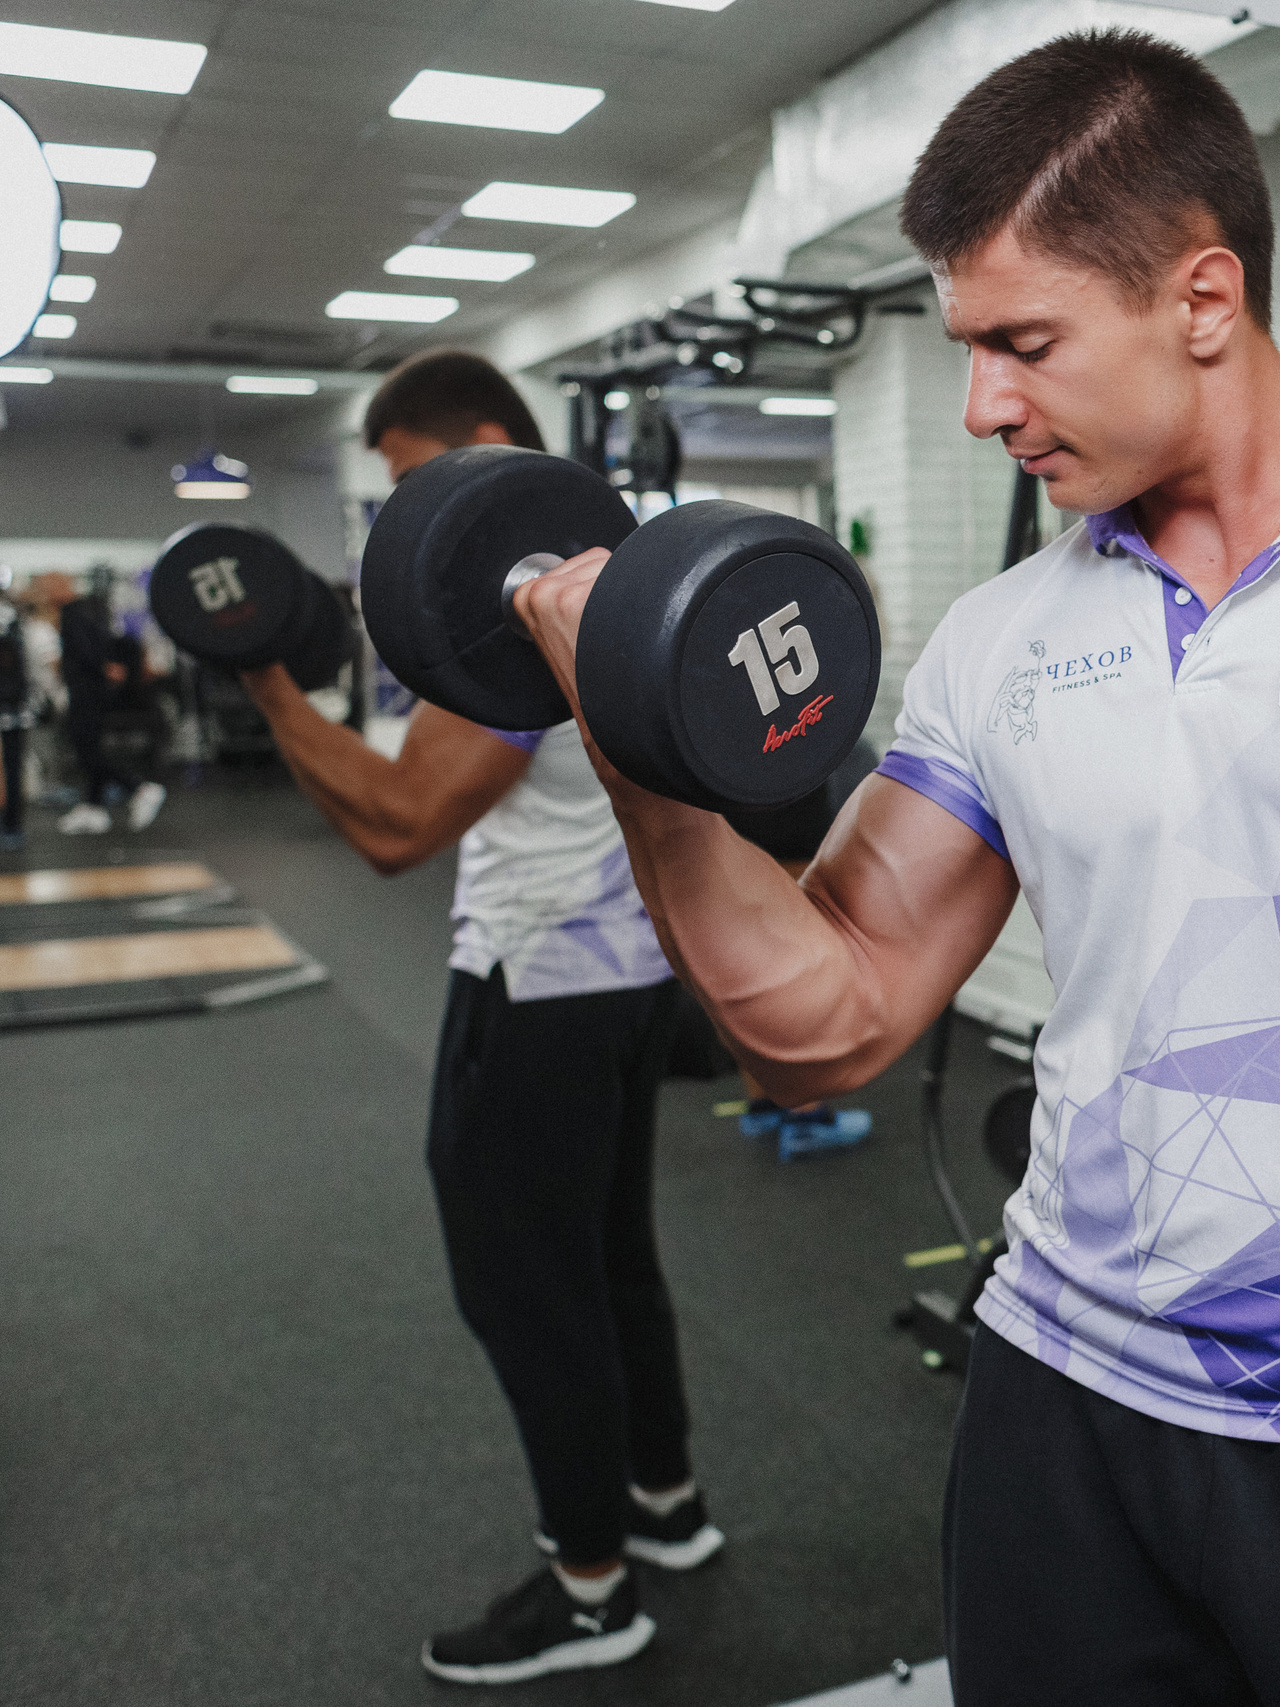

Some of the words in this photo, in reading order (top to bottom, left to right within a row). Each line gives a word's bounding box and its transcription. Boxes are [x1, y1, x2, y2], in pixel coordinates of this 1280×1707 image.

[727, 600, 820, 716] 15
[1045, 645, 1133, 680] ЧЕХОВ
[1052, 678, 1092, 694] FITNESS
[1093, 676, 1100, 684] &
[1102, 672, 1123, 681] SPA
